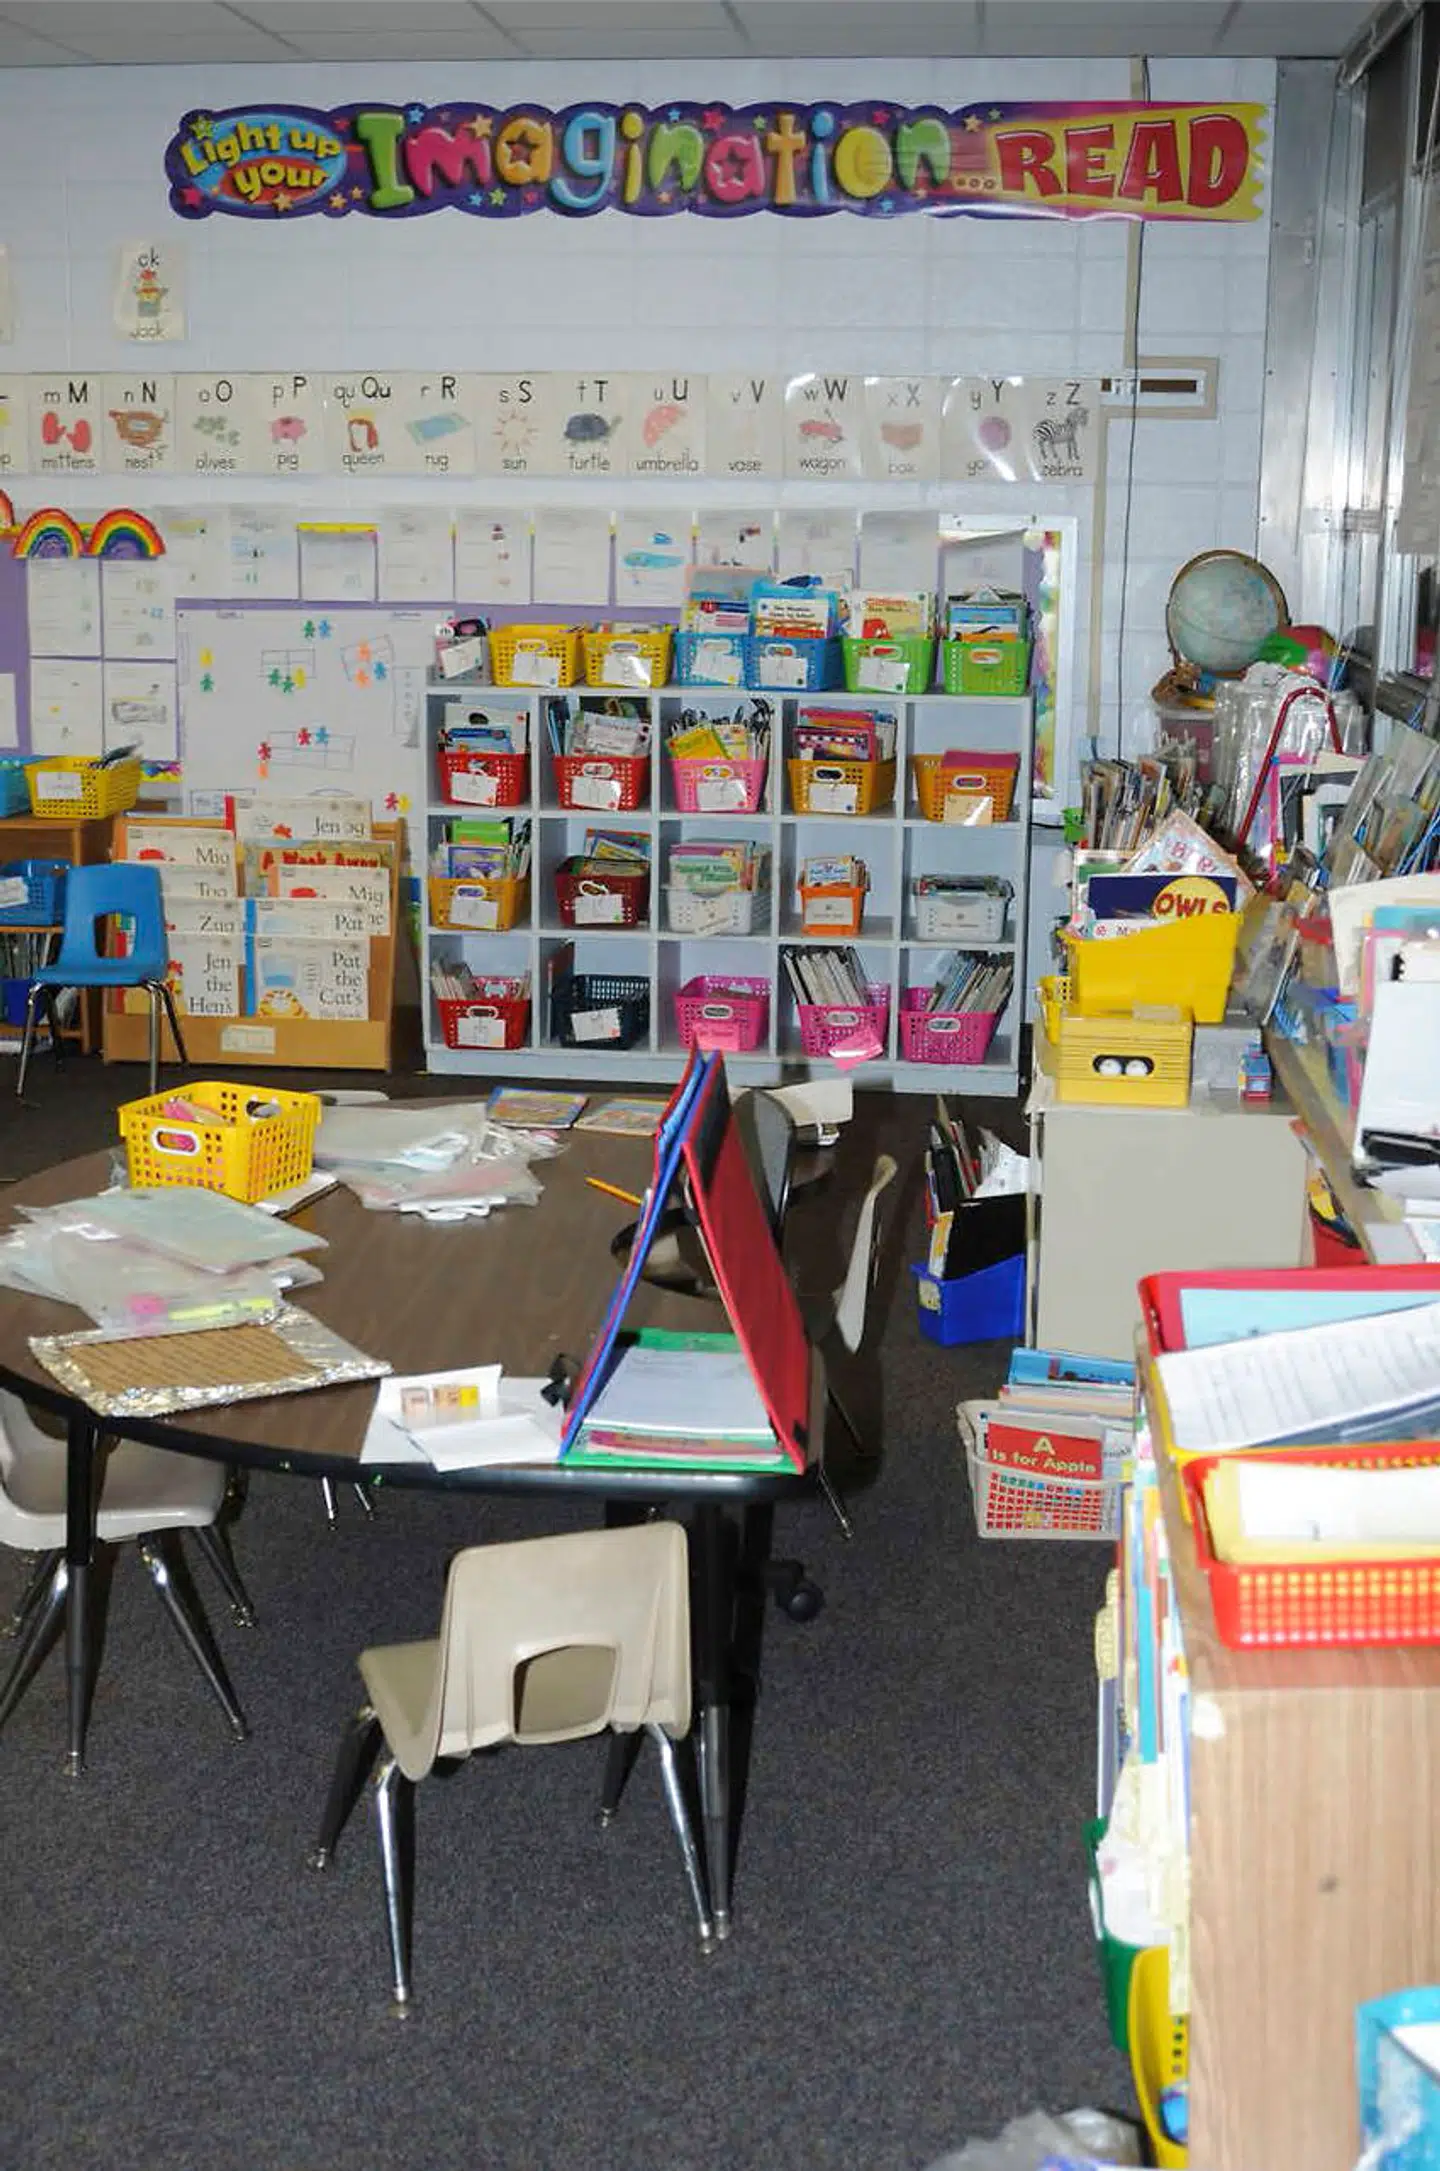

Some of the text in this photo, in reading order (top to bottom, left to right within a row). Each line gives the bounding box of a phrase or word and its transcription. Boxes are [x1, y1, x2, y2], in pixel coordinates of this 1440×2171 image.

[181, 122, 342, 176] Light up
[996, 113, 1249, 208] READ
[234, 161, 329, 200] your
[361, 376, 391, 399] Qu
[824, 379, 847, 401] W
[41, 453, 95, 469] mittens
[195, 454, 236, 470] olives
[277, 455, 299, 470] pig
[342, 454, 384, 472] queen
[425, 455, 449, 470] rug
[502, 458, 527, 470] sun
[568, 453, 610, 470] turtle
[636, 449, 698, 471] umbrella
[728, 459, 762, 472] vase
[799, 456, 846, 475] wagon
[335, 914, 364, 931] Pat
[203, 953, 231, 973] Jen
[333, 951, 360, 969] Pat
[206, 976, 232, 992] the
[335, 969, 361, 986] the
[319, 988, 363, 1005] Cat's
[1033, 1436, 1056, 1456] A
[1012, 1451, 1037, 1466] for
[1043, 1457, 1096, 1473] Apple
